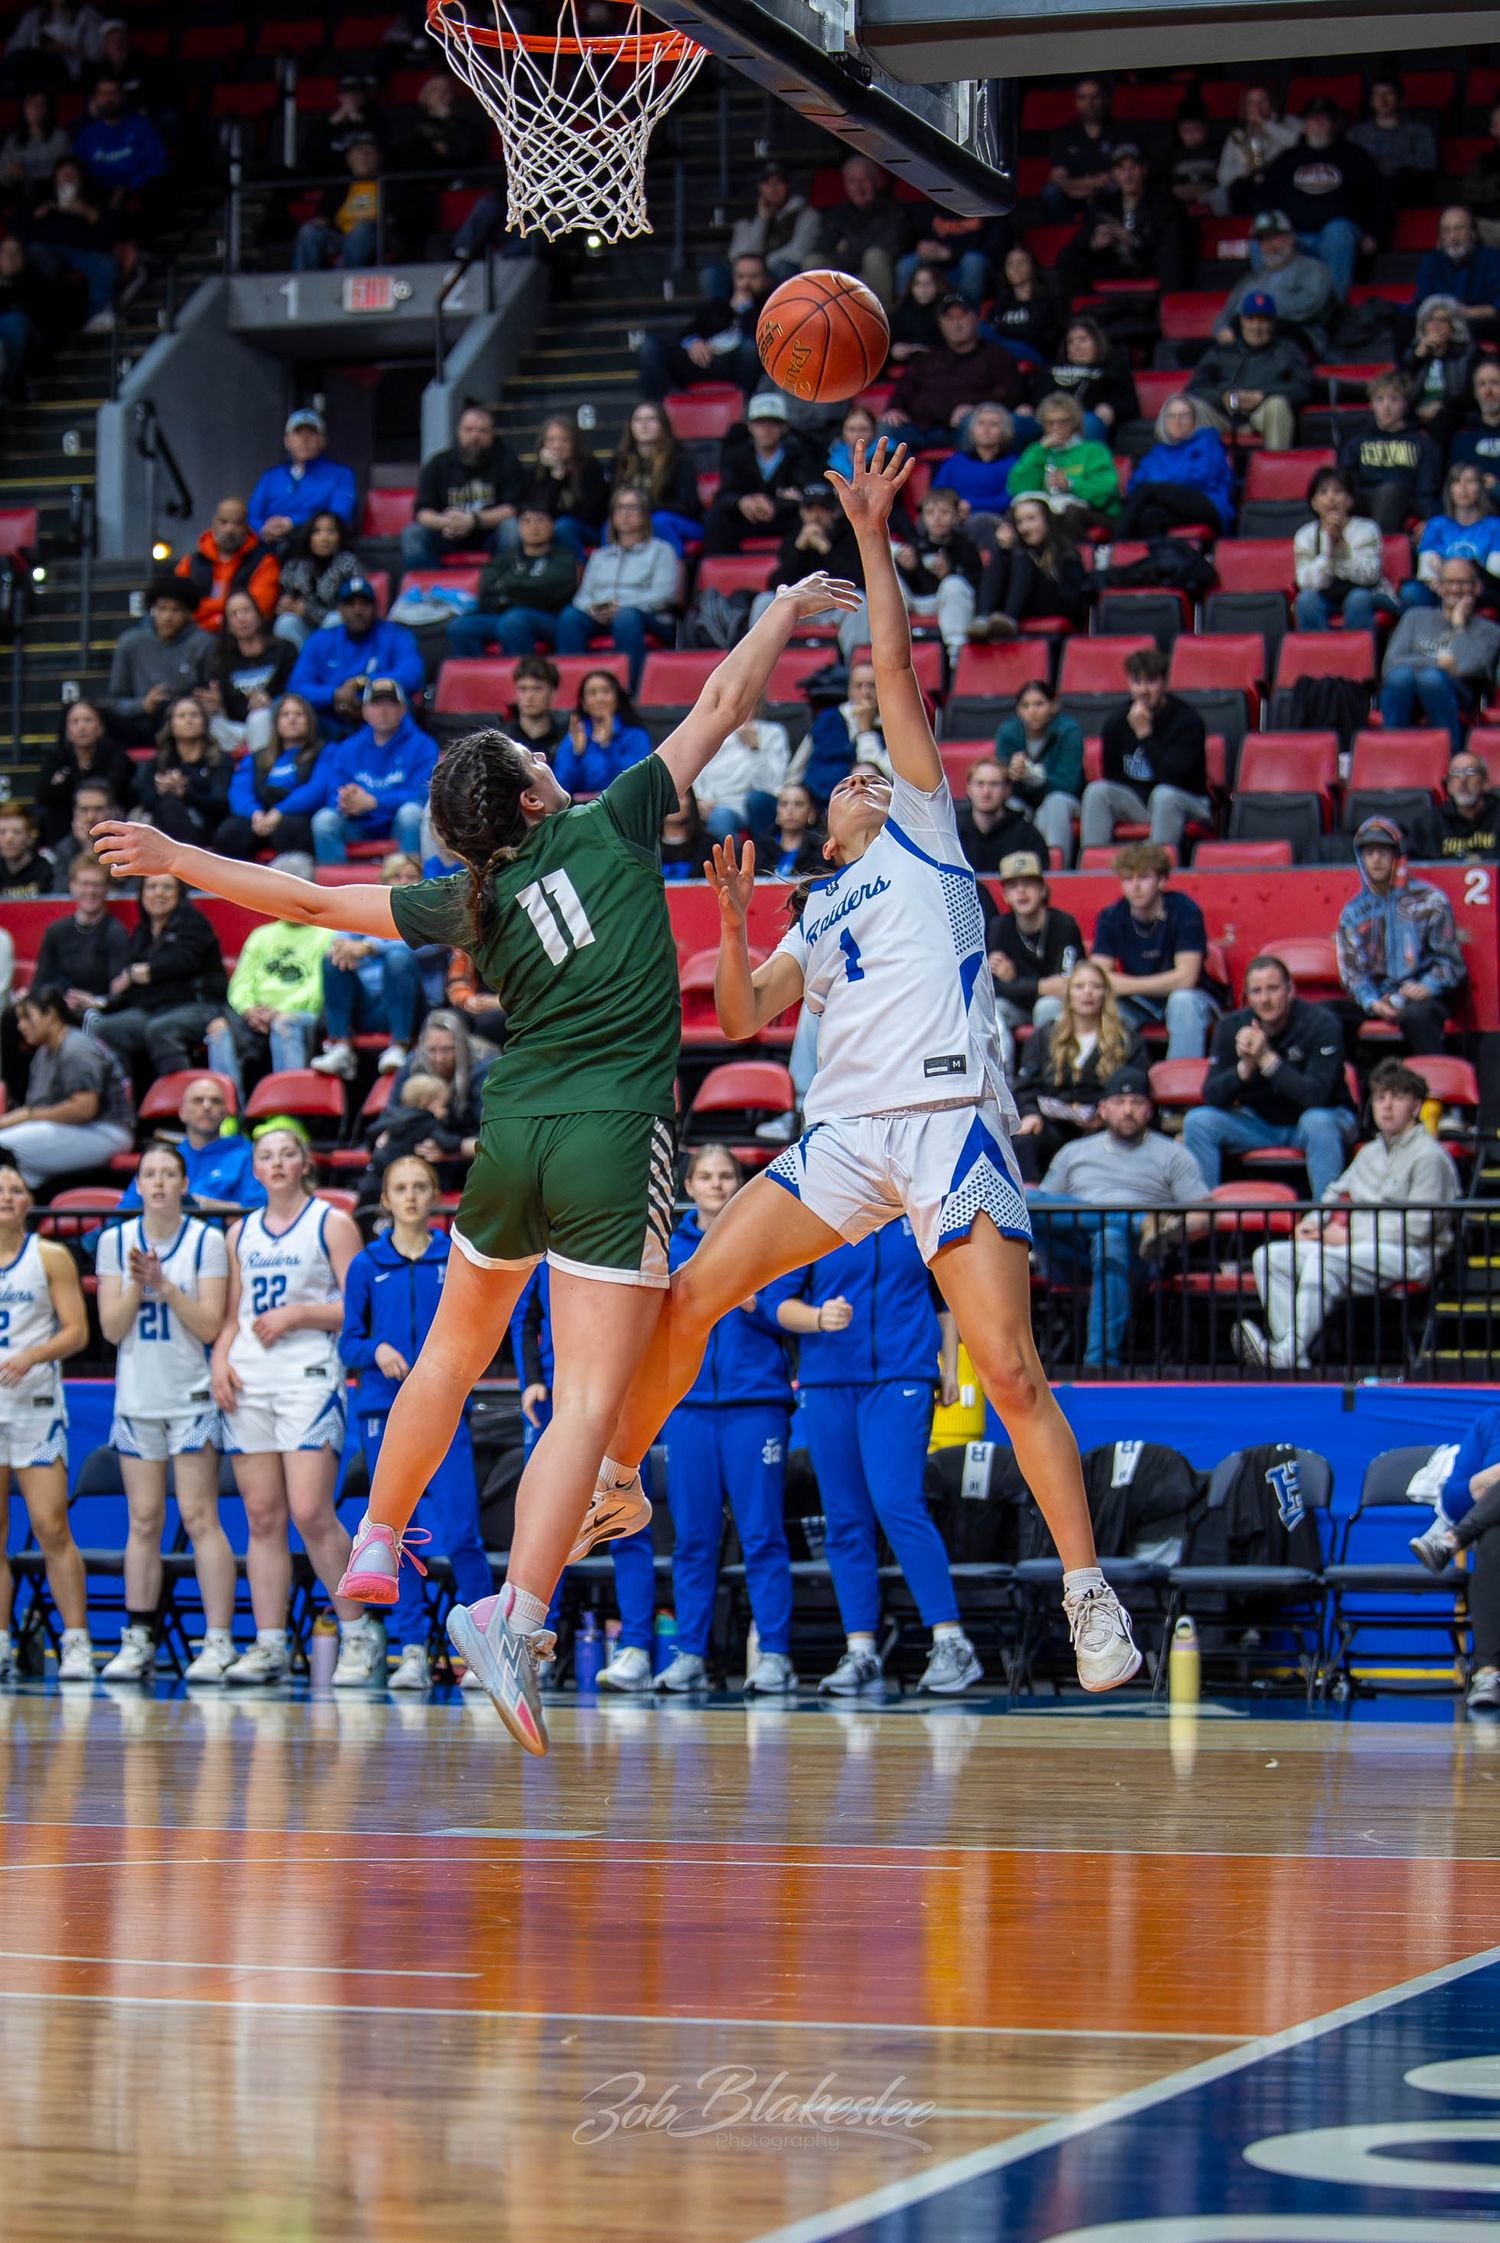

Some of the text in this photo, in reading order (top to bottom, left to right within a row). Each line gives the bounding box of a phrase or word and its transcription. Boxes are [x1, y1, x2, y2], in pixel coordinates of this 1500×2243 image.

[1463, 868, 1491, 906] 2
[514, 867, 597, 967] 11
[839, 926, 865, 983] 1
[952, 1060, 961, 1069] M
[251, 1274, 288, 1316] 22
[138, 1300, 171, 1341] 21
